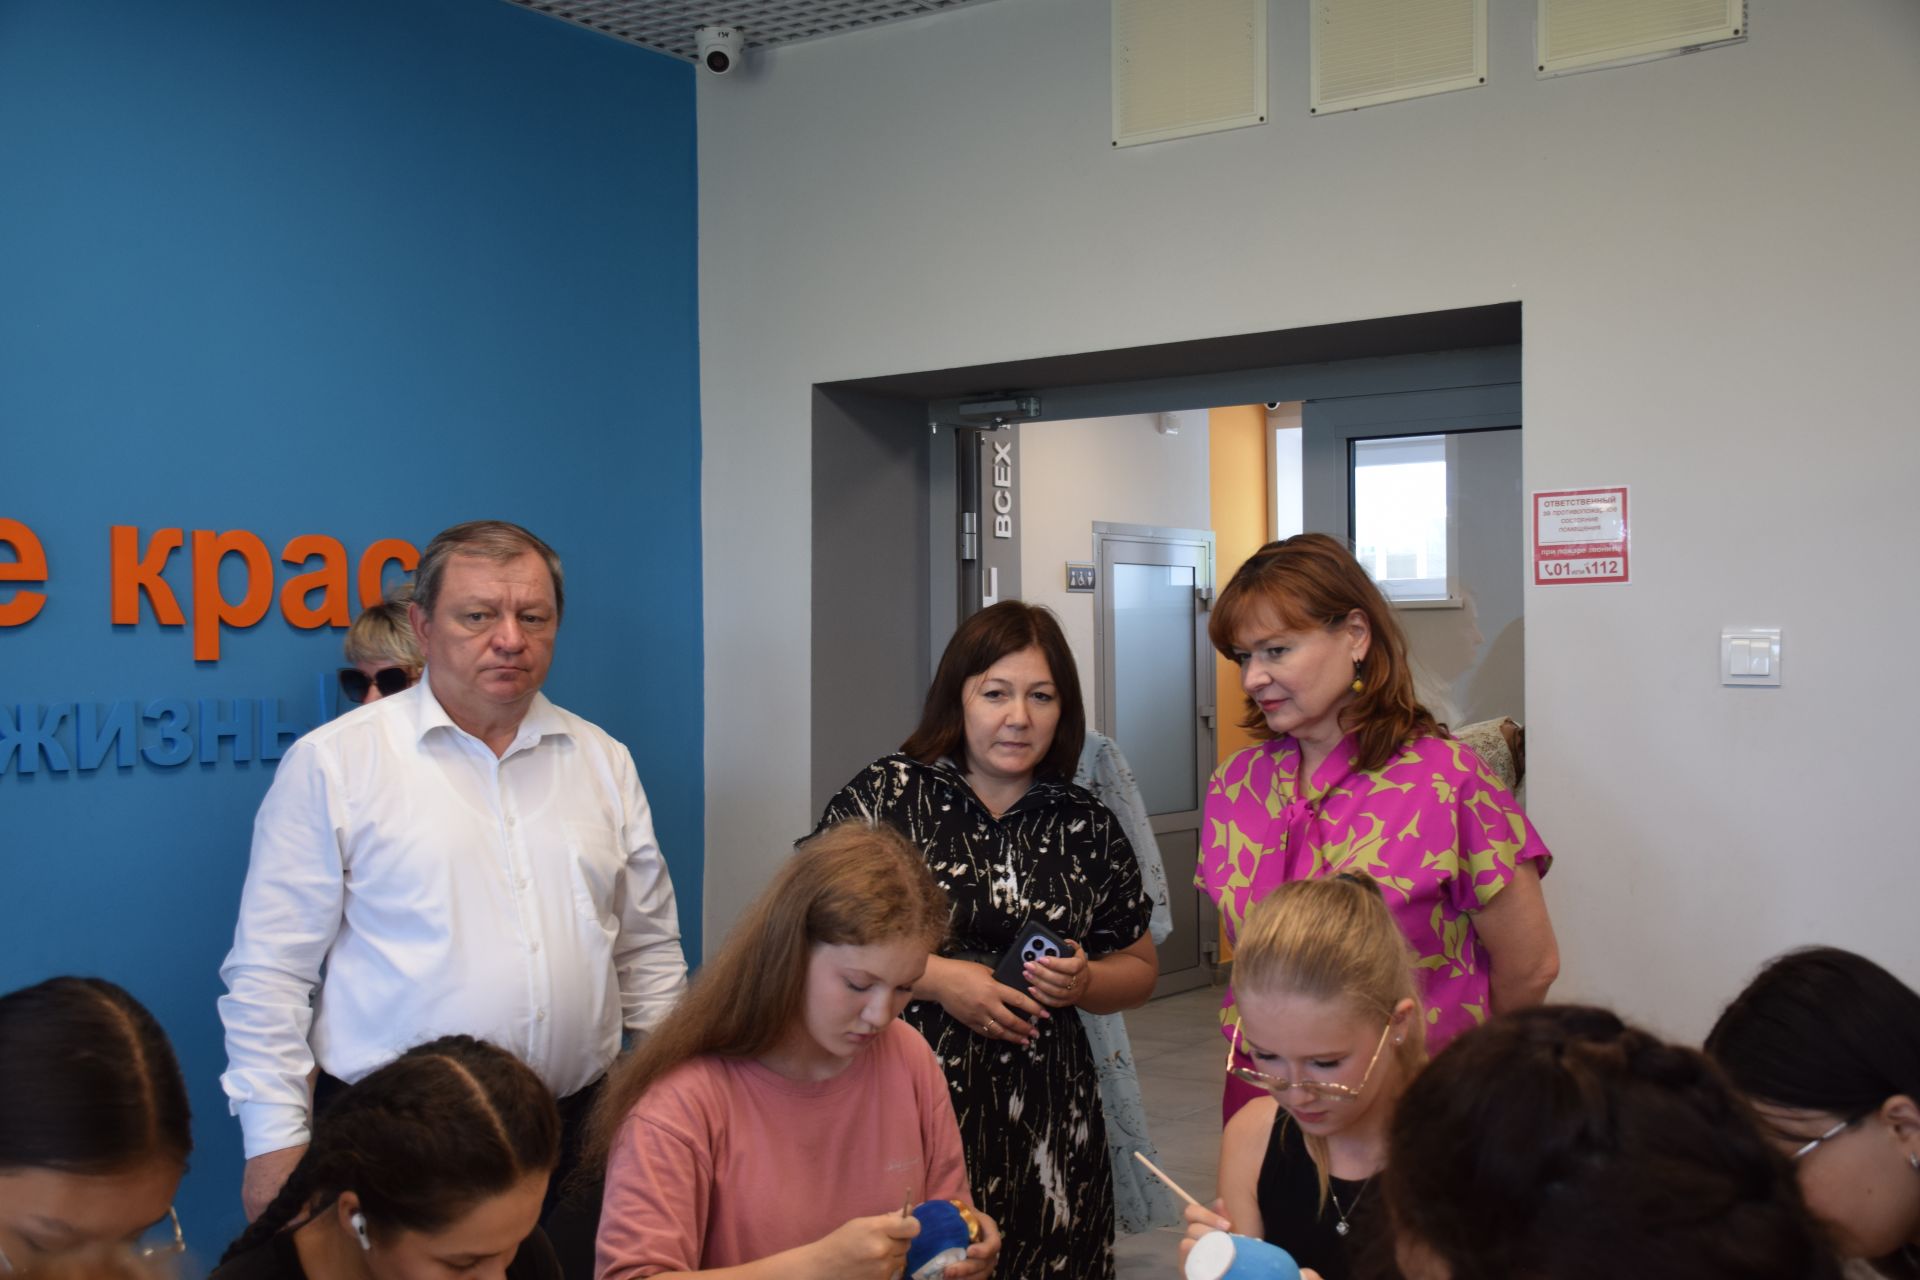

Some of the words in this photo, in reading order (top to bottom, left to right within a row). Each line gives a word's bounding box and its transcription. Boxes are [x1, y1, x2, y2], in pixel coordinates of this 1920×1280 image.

[994, 441, 1012, 538] ВСЕХ
[1543, 496, 1616, 508] ОТВЕТСТВЕННЫЙ
[1553, 562, 1570, 576] 01
[1591, 560, 1618, 575] 112
